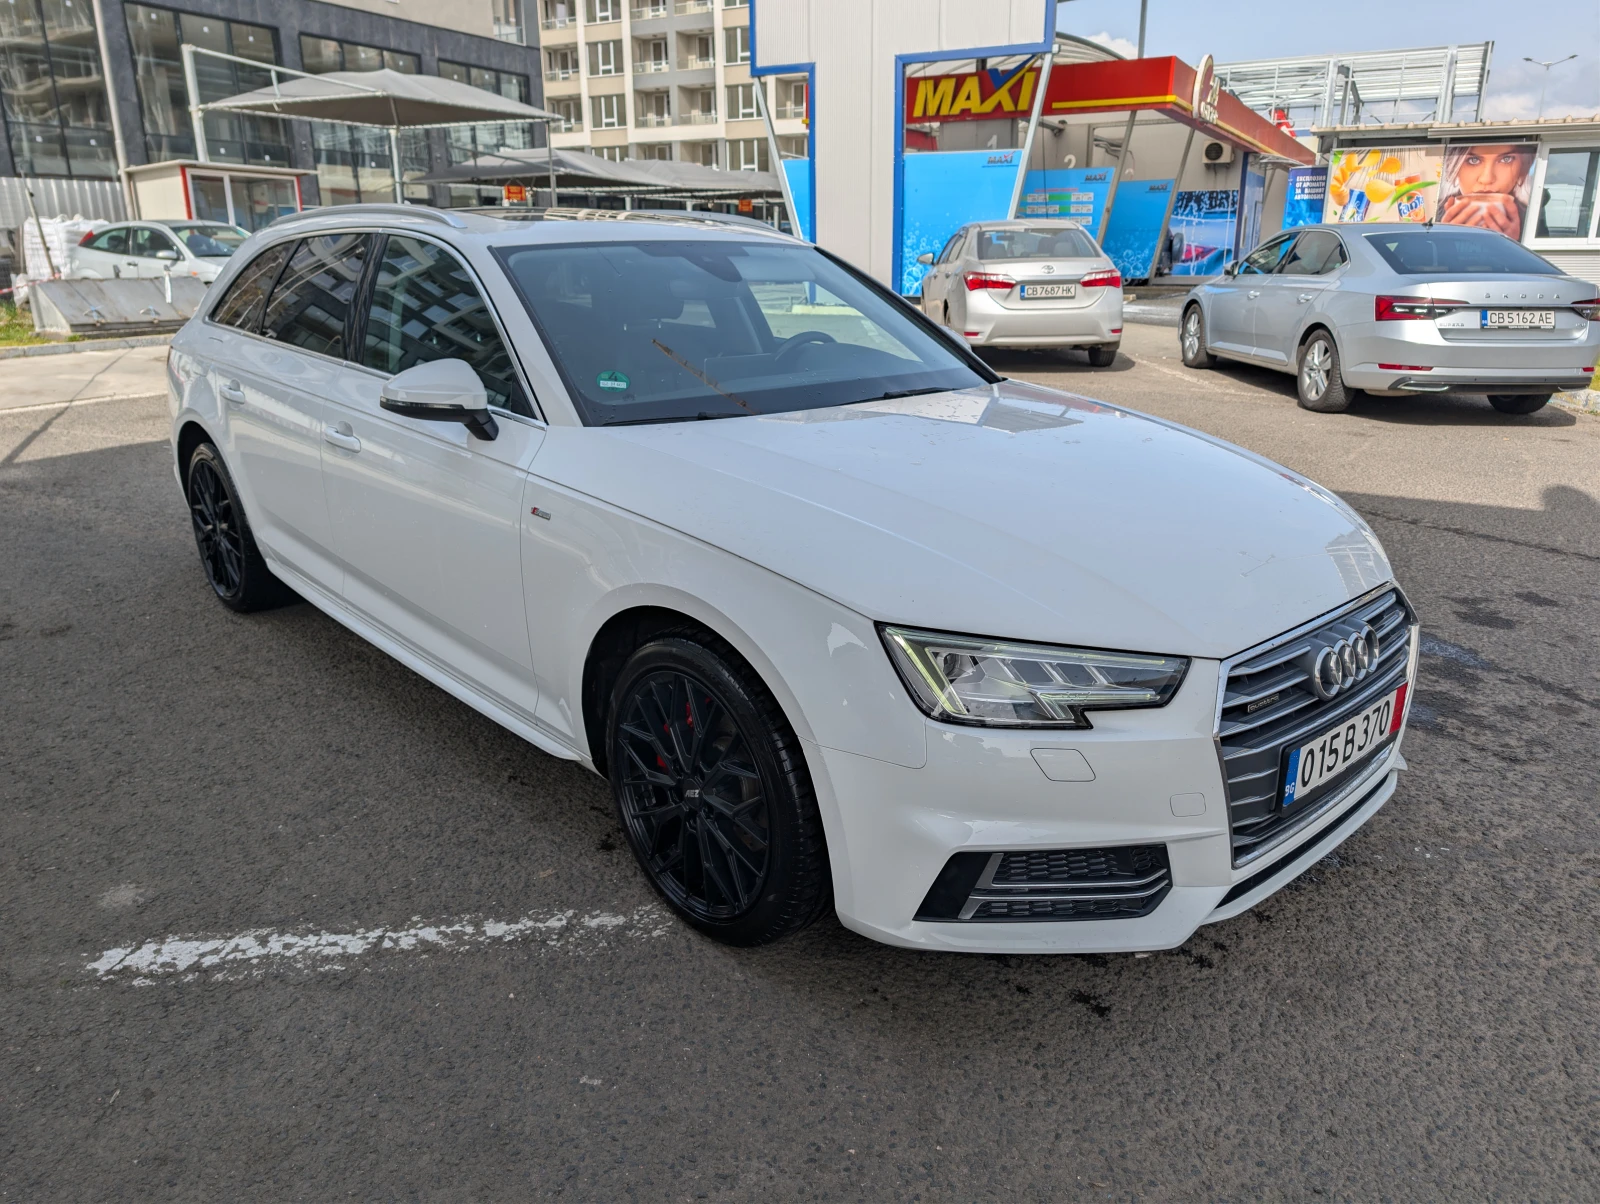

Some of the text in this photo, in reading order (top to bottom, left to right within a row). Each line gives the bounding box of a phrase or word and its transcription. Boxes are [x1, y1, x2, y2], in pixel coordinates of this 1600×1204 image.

[913, 62, 1038, 117] MAXI
[988, 153, 1014, 164] MAXI
[1085, 173, 1107, 182] MAXI
[1149, 183, 1168, 191] MAXI
[1026, 285, 1073, 297] CB 7687 HK
[1490, 312, 1553, 324] CB 5162 AE
[608, 371, 618, 382] 4
[685, 789, 700, 798] AEZ
[1285, 782, 1296, 796] BG
